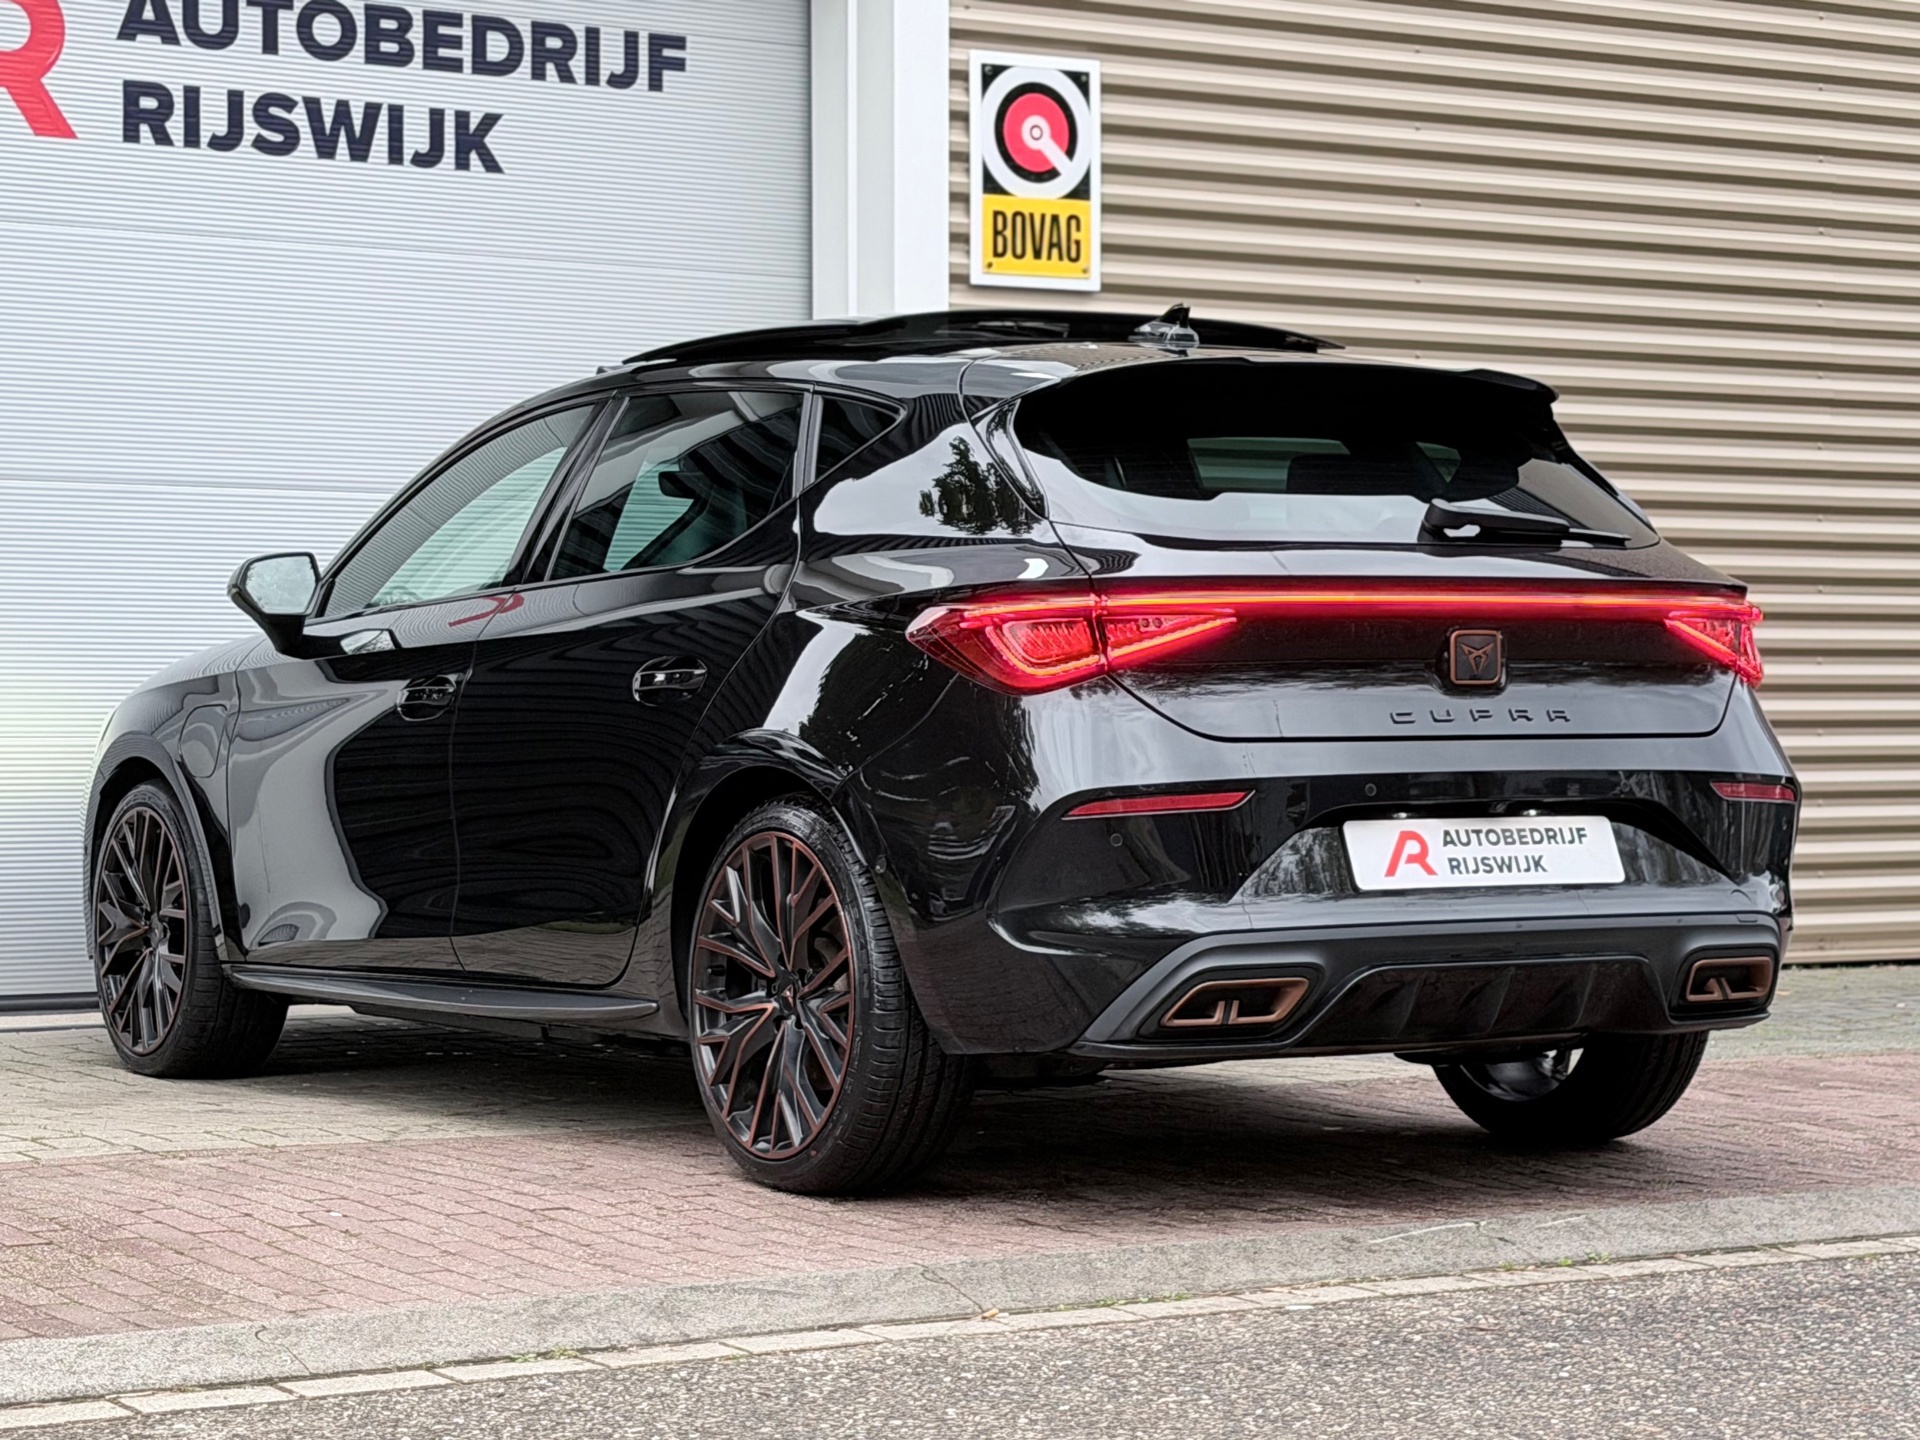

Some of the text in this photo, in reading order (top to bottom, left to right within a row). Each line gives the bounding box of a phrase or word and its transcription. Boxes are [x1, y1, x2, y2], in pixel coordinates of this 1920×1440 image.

[117, 0, 687, 92] AUTOBEDRIJF
[122, 80, 505, 173] RIJSWIJK
[992, 210, 1081, 263] BOVAG
[1442, 827, 1587, 847] AUTOBEDRIJF
[1447, 855, 1548, 875] RIJSWIJK
